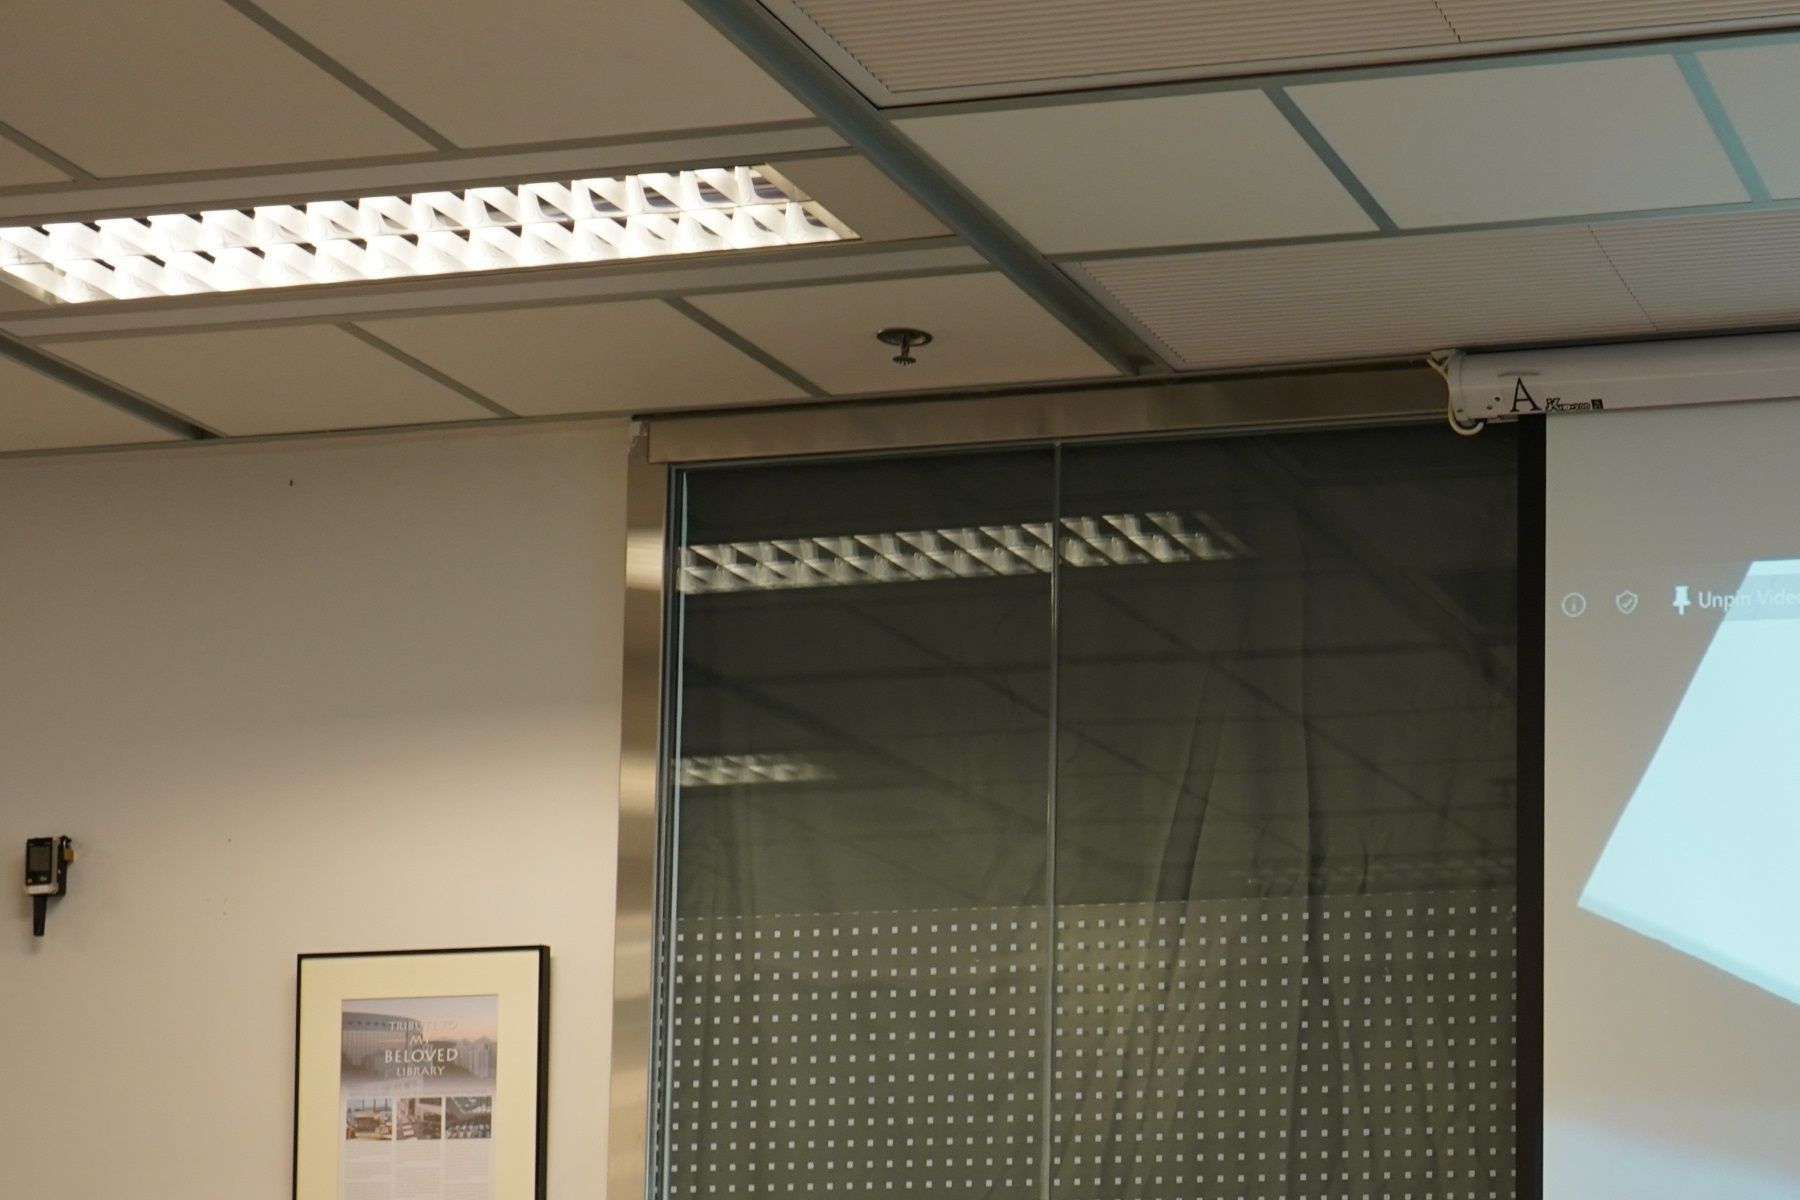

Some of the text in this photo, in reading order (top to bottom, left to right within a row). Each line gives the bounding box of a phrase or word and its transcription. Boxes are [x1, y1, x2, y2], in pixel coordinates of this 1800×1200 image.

[1698, 589, 1751, 613] Unpin
[384, 1047, 459, 1064] BELOVED
[396, 1065, 446, 1077] LIBRARY
